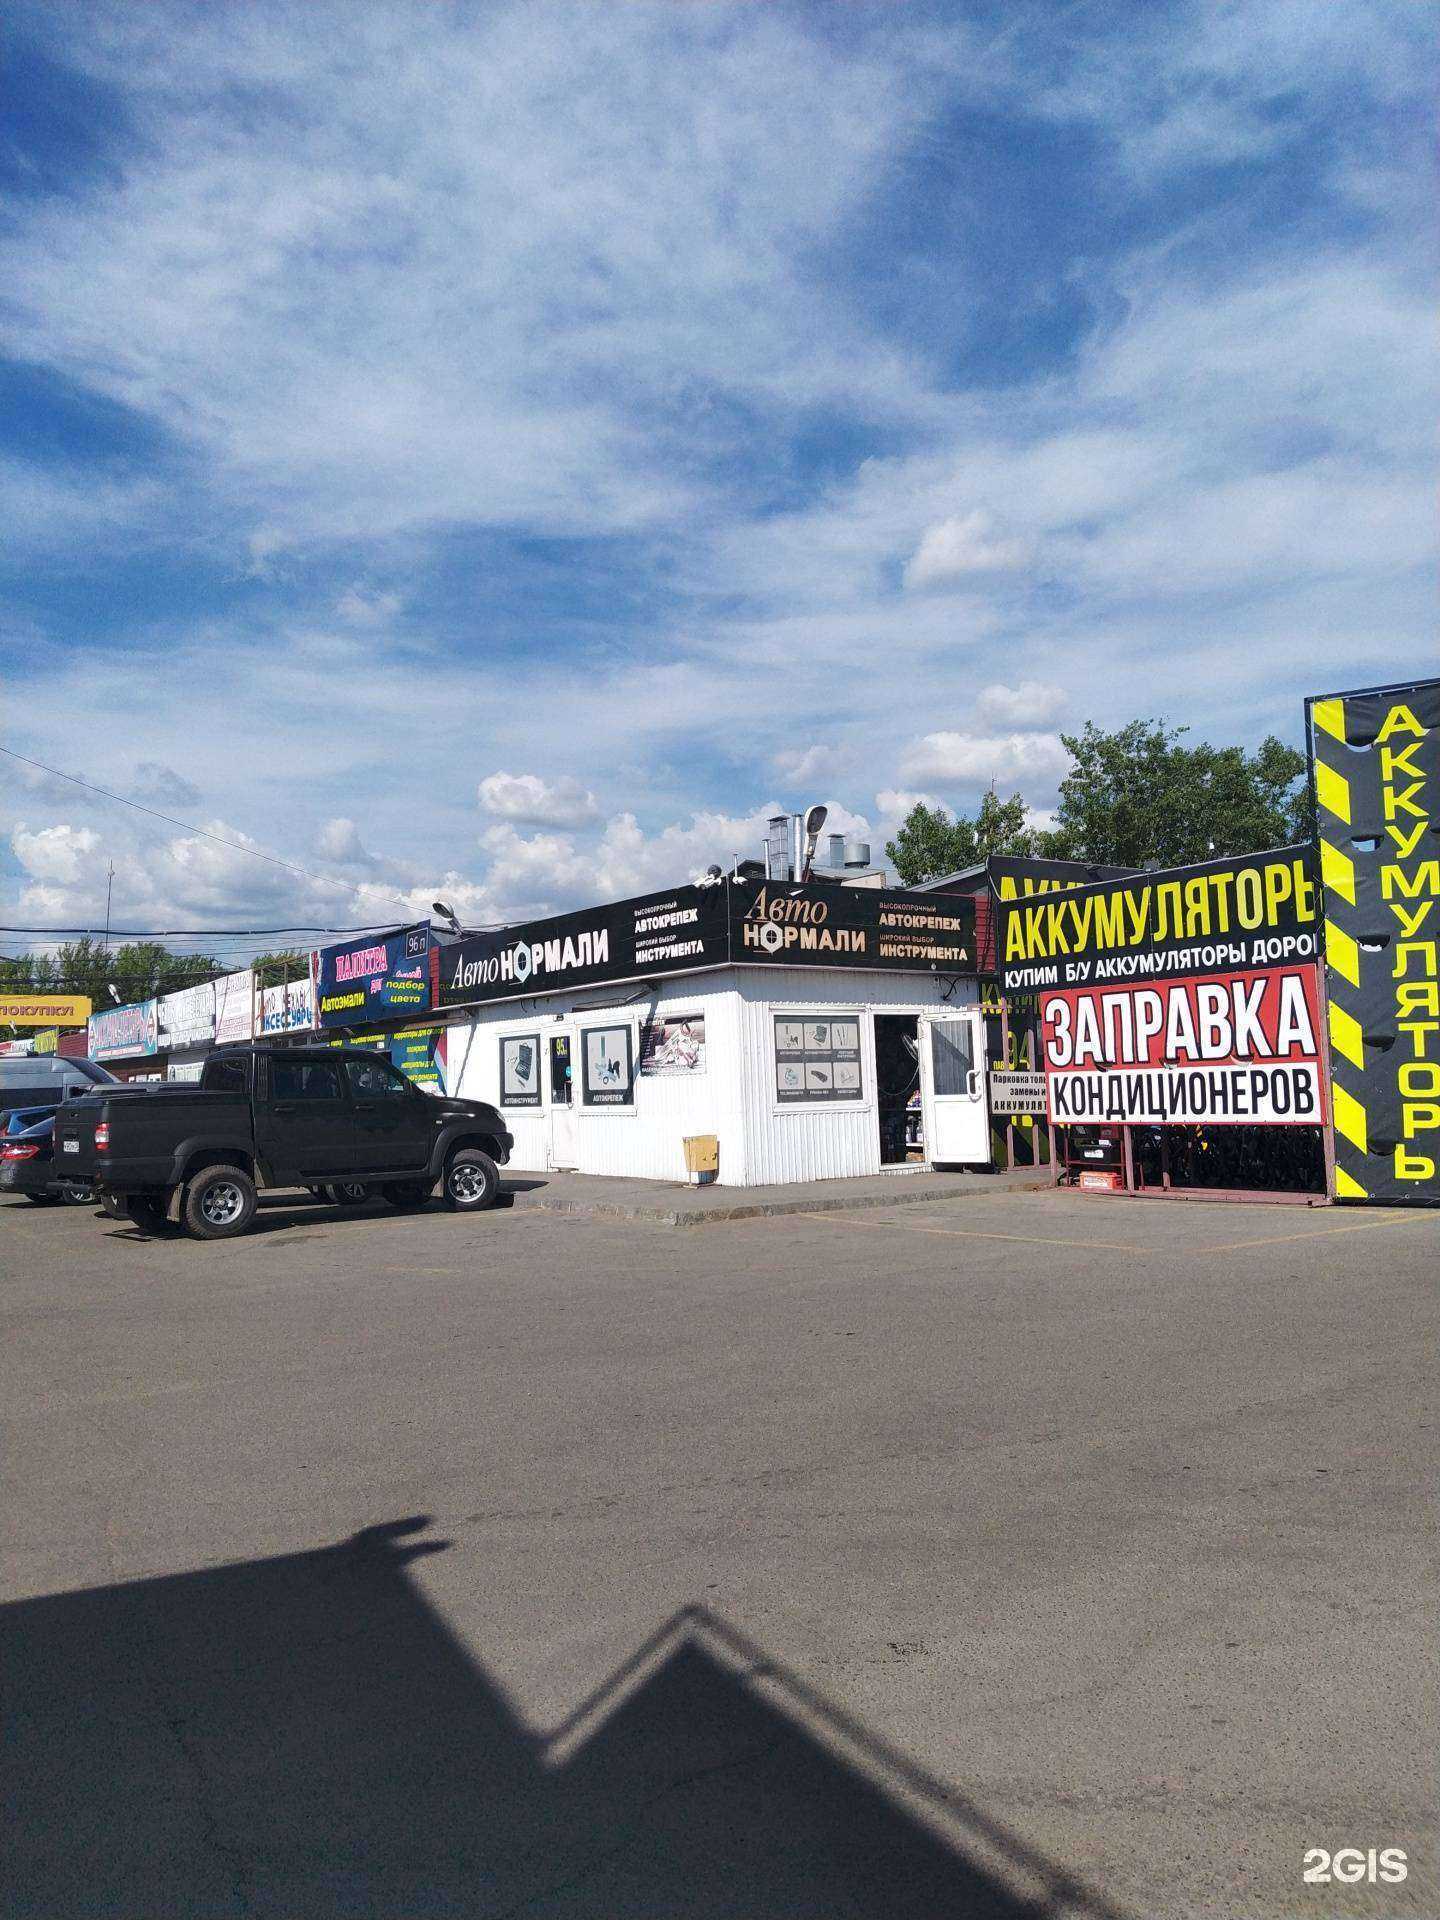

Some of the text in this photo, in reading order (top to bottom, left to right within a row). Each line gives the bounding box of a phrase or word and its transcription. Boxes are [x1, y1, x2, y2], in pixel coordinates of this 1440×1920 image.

[743, 886, 828, 924] Авто
[879, 902, 937, 913] ВЫСОКОПРОЧНЫЙ
[634, 908, 699, 934] АВТОКРЕПЕЖ
[879, 913, 961, 931] АВТОКРЕПЕЖ
[408, 937, 418, 952] 96
[743, 921, 866, 954] НОРМАЛИ
[336, 945, 388, 982] ПАЛИТРА
[450, 929, 609, 990] Авто НОРМАЛИ
[635, 939, 704, 964] ИНСТРУМЕНТА
[879, 943, 968, 961] ИНСТРУМЕНТА
[1004, 965, 1058, 989] КУПИМ
[1065, 961, 1092, 982] Б/У
[1095, 943, 1246, 979] АККУМУЛЯТОРЫ
[386, 980, 426, 992] подбор
[390, 994, 421, 1003] цвета
[320, 991, 366, 1013] Автоэмали
[1046, 974, 1317, 1066] ЗАПРАВКА
[993, 1074, 1029, 1085] Парковка
[1054, 1069, 1315, 1120] КОНДИЦИОНЕРОВ
